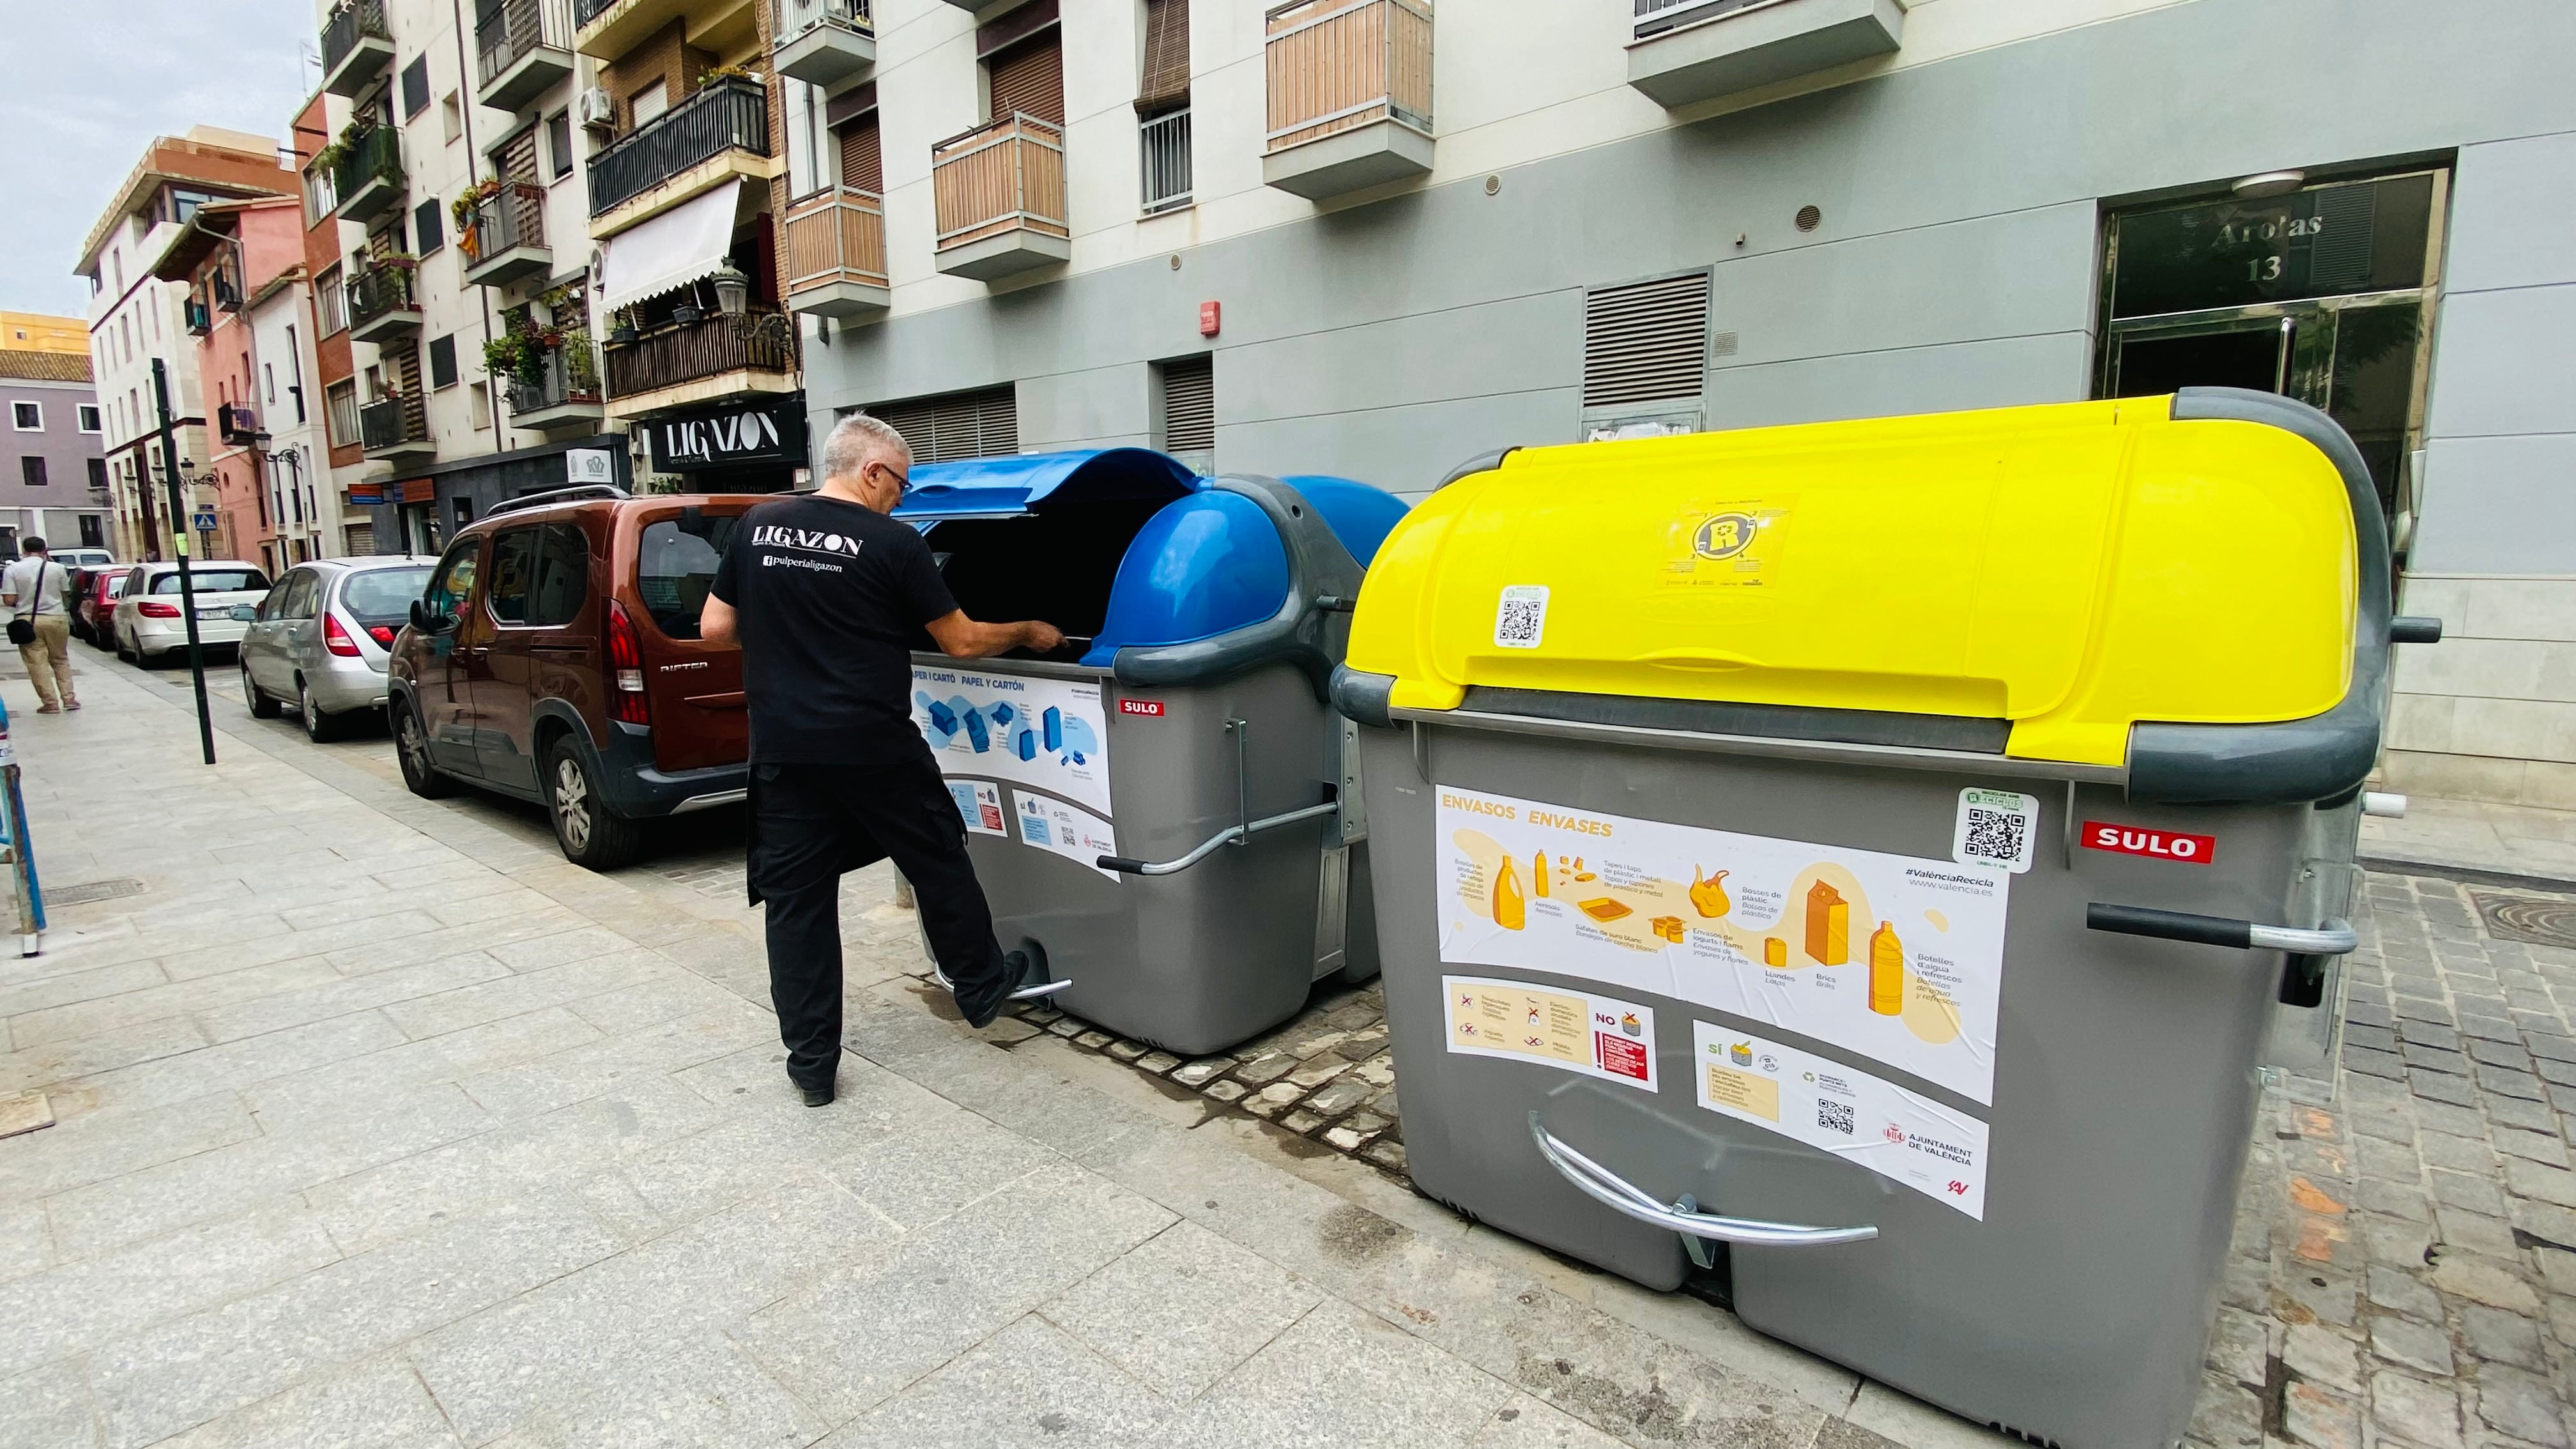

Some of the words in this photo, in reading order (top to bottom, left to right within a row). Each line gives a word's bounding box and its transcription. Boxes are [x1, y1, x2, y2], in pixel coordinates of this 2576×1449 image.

[2211, 215, 2323, 249] Arolas
[2247, 256, 2281, 282] 13
[666, 410, 779, 462] LIGAZON
[751, 525, 864, 556] LIGAZON
[773, 556, 843, 572] pulperialigazon
[962, 675, 985, 687] PAPEL
[986, 679, 991, 688] Y
[993, 679, 1025, 691] CARTÓN
[1124, 702, 1158, 714] SULO
[1443, 793, 1516, 820] ENVASOS
[1528, 810, 1613, 838] ENVASES
[2096, 828, 2196, 857] SULO
[1604, 860, 1622, 869] Tapes
[1906, 869, 1994, 887] #ValènciaRecicla
[1742, 886, 1770, 896] Bosses
[1535, 901, 1560, 911] Aerosols
[1742, 901, 1767, 911] Bolsas
[1623, 935, 1643, 944] blanc
[1692, 928, 1722, 939] Envasos
[1636, 944, 1659, 954] blanco
[1693, 942, 1721, 953] Envases
[1693, 949, 1721, 959] yogures
[1918, 953, 1954, 966] Botelles
[1765, 970, 1796, 982] Llandes
[1816, 973, 1836, 983] Brics
[1922, 970, 1963, 983] refrescos
[1917, 977, 1951, 990] Botellas
[1922, 994, 1961, 1007] refrescos
[1596, 1013, 1616, 1025] NO
[1908, 1142, 1922, 1151] DE
[1909, 1133, 1974, 1158] AJUNTAMENT
